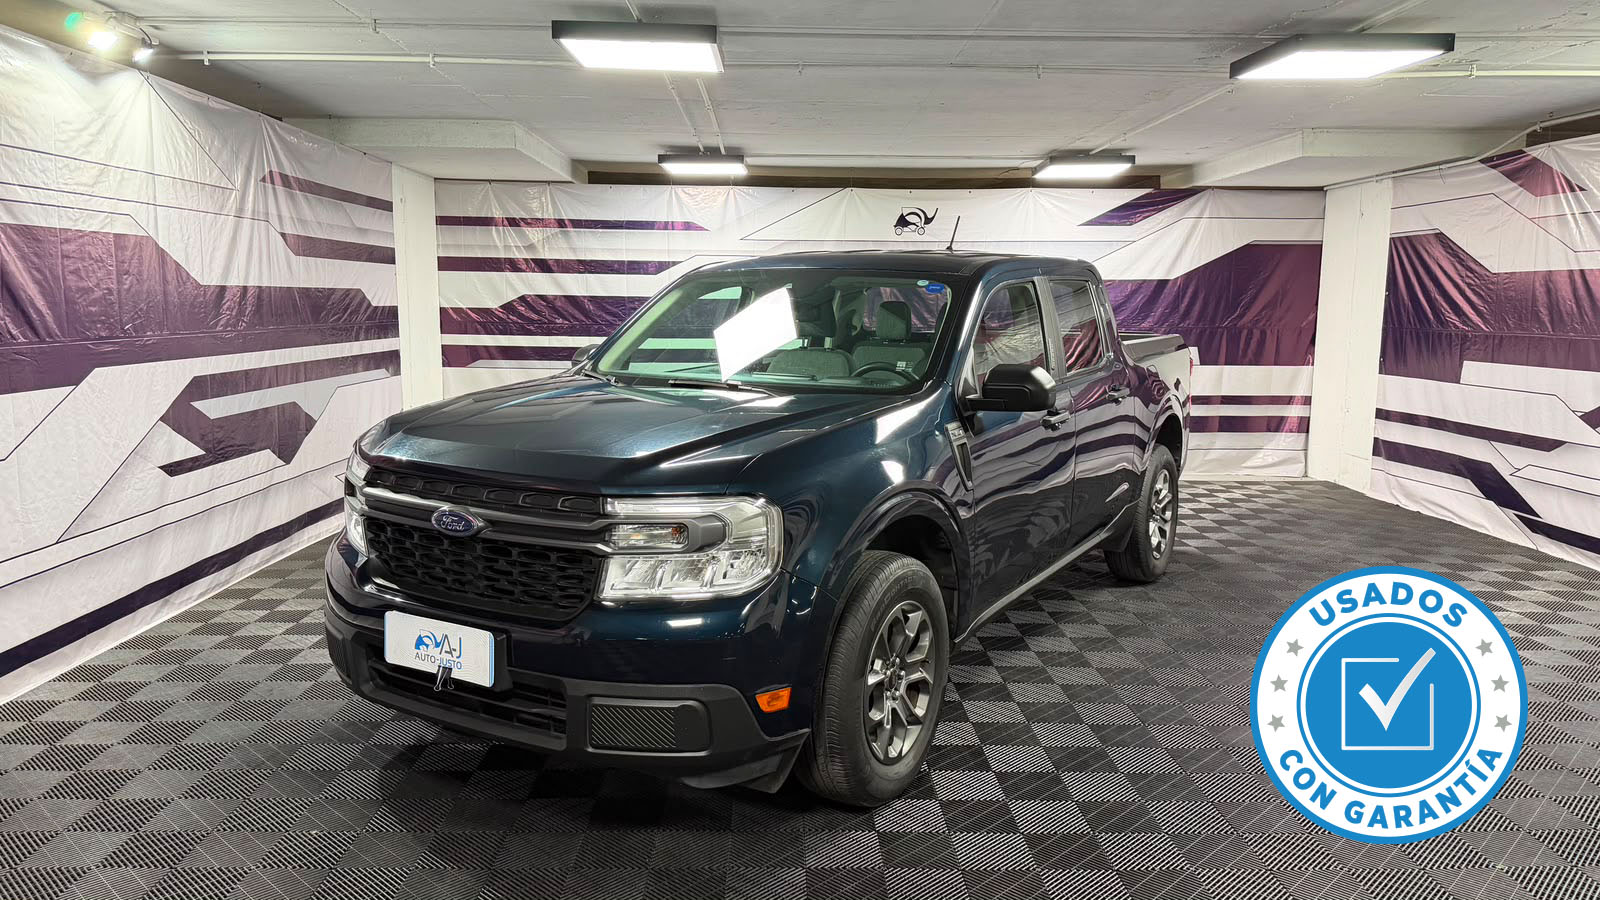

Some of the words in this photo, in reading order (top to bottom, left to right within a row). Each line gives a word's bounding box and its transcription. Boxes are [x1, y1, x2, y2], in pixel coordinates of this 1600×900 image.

[440, 514, 465, 531] Ford
[439, 633, 463, 659] A-J
[414, 652, 463, 670] AUTO-JUSTO
